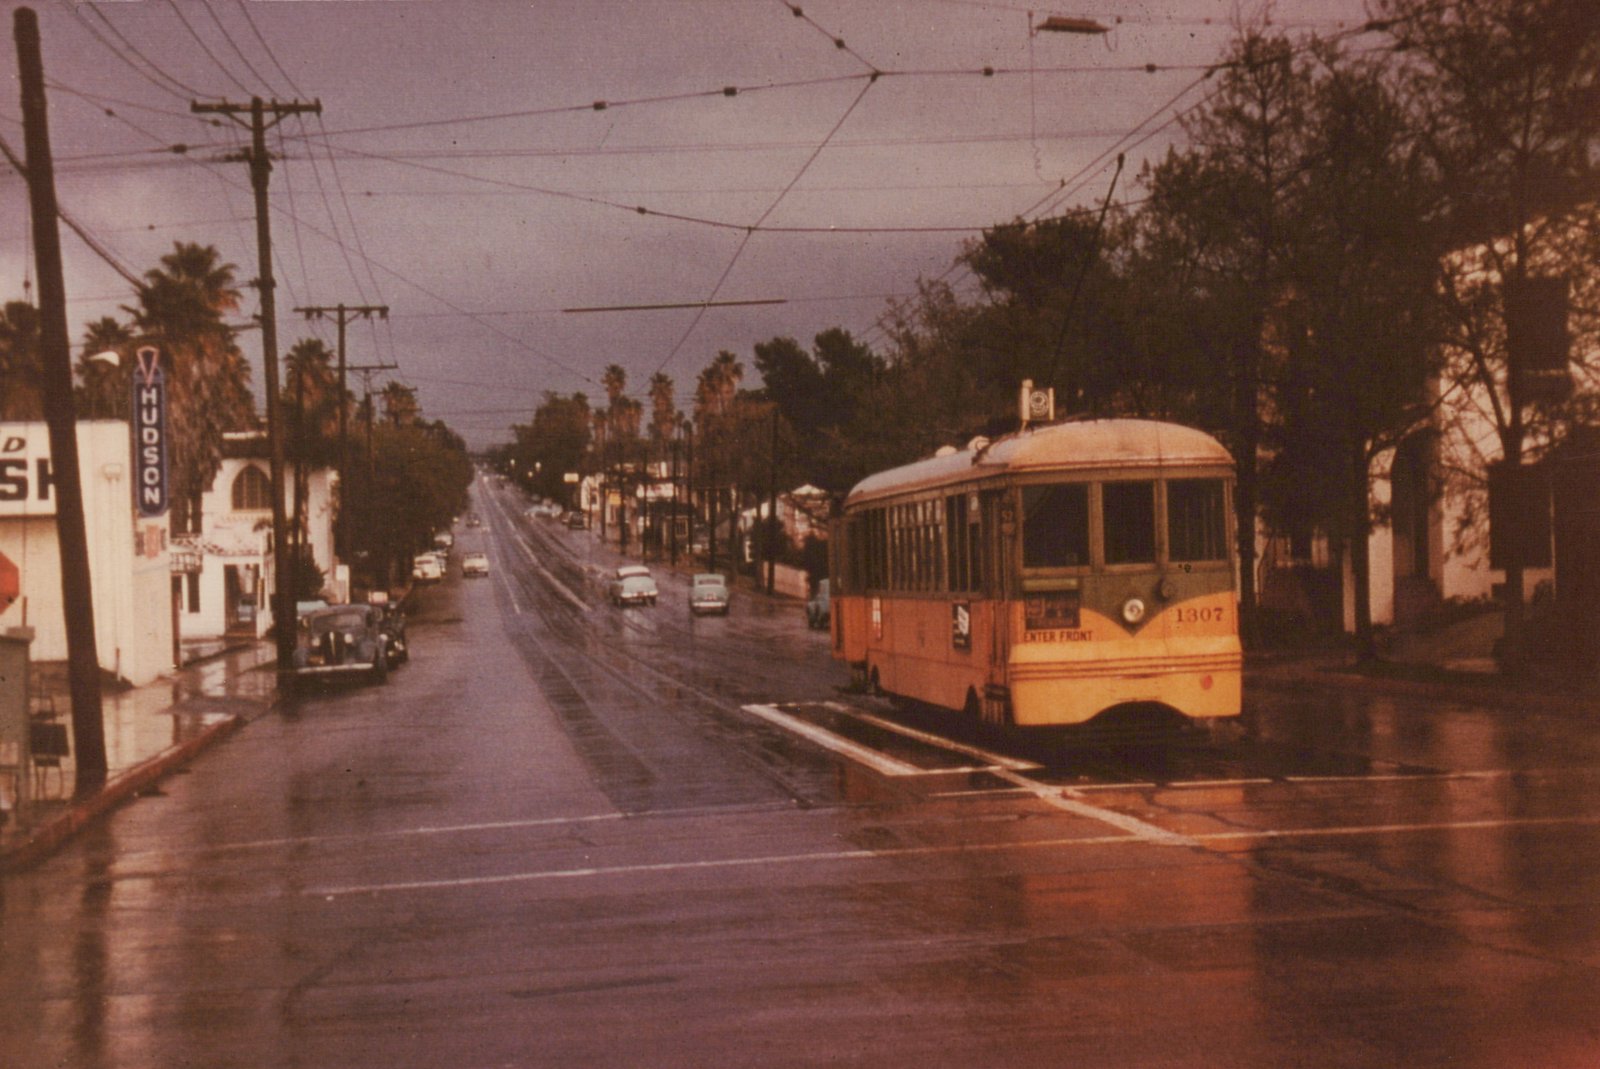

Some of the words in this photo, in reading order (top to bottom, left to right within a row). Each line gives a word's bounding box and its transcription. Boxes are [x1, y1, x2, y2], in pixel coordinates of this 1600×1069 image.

[141, 387, 160, 504] HUDSON
[1177, 607, 1223, 622] 1307
[1024, 631, 1056, 642] ENTER
[1060, 630, 1093, 642] FRONT
